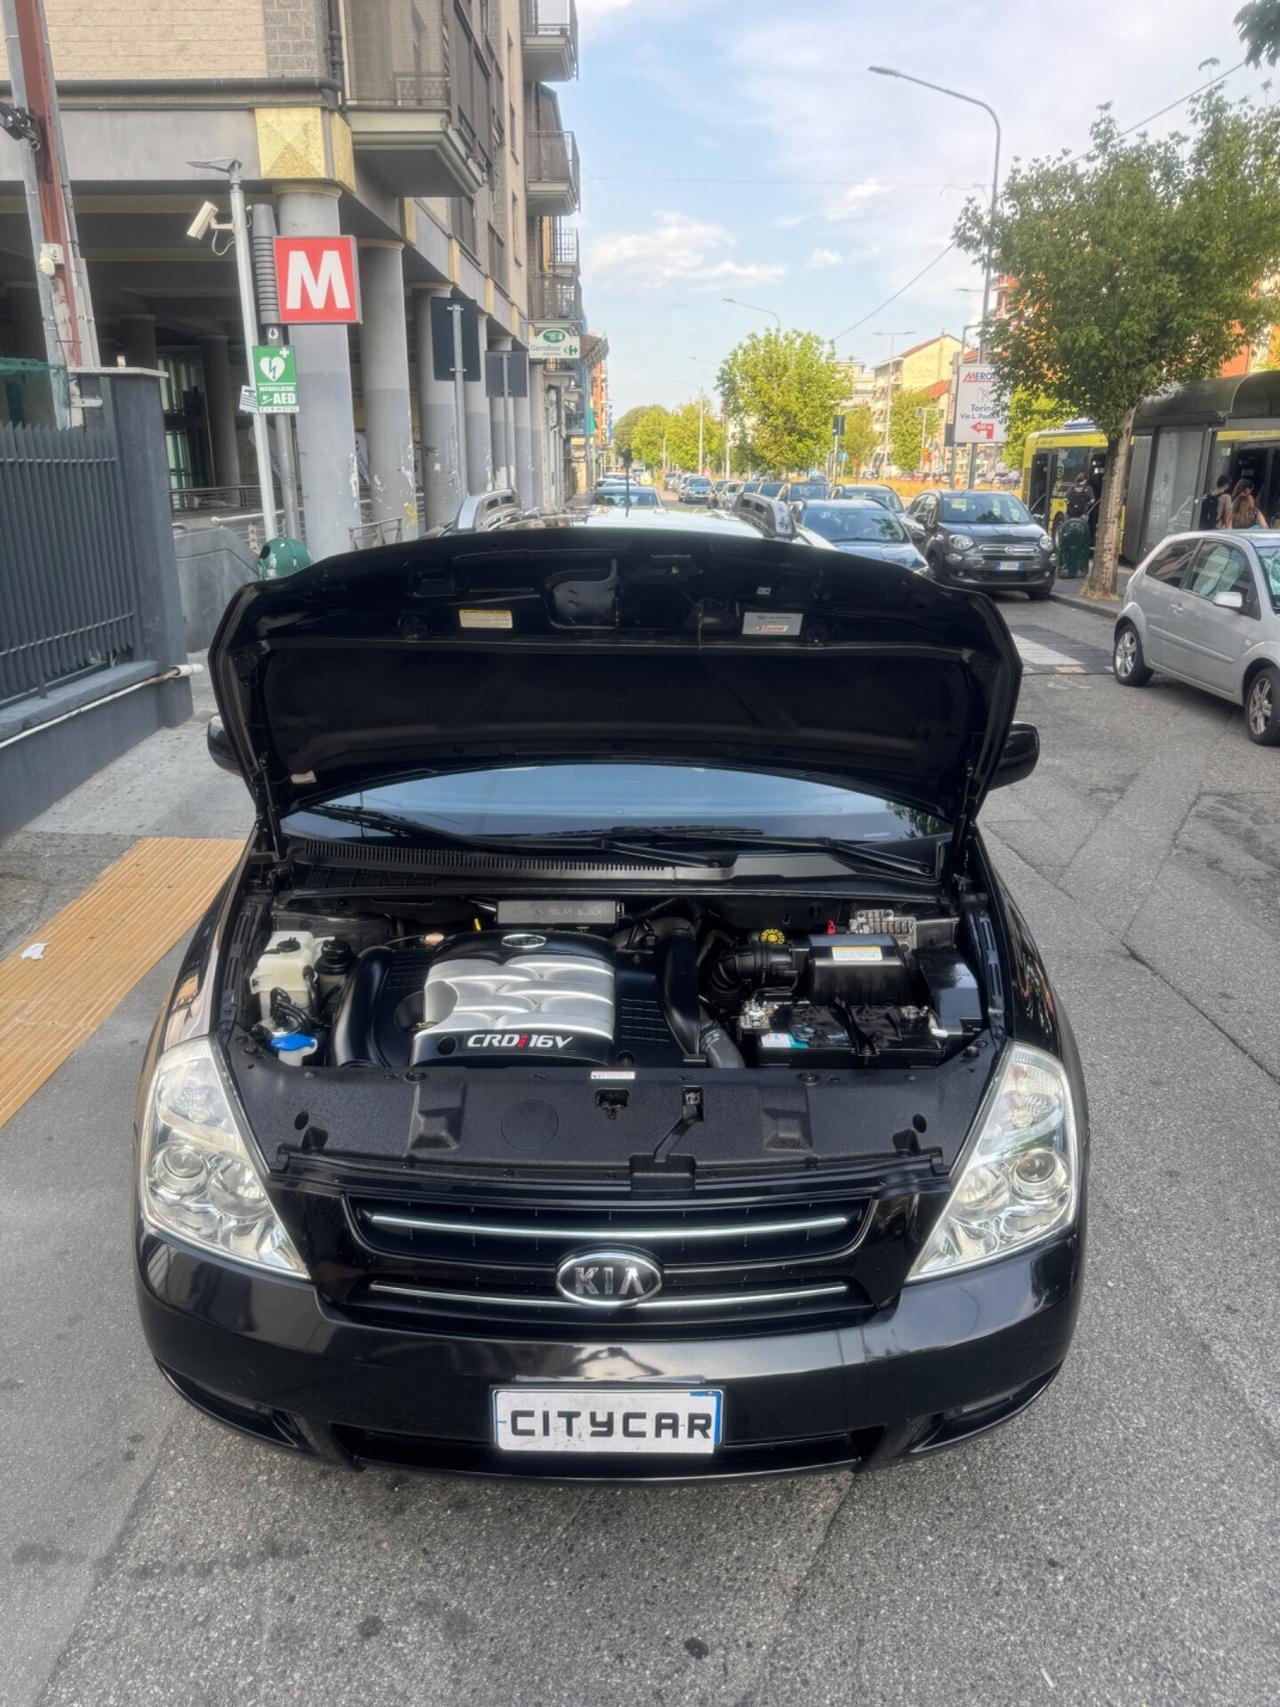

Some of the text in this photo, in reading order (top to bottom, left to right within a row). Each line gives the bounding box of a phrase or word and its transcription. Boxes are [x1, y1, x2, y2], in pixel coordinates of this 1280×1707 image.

[286, 250, 351, 309] M
[273, 392, 296, 405] AED
[574, 1267, 645, 1295] KIA
[511, 1410, 713, 1439] CITYCAR
